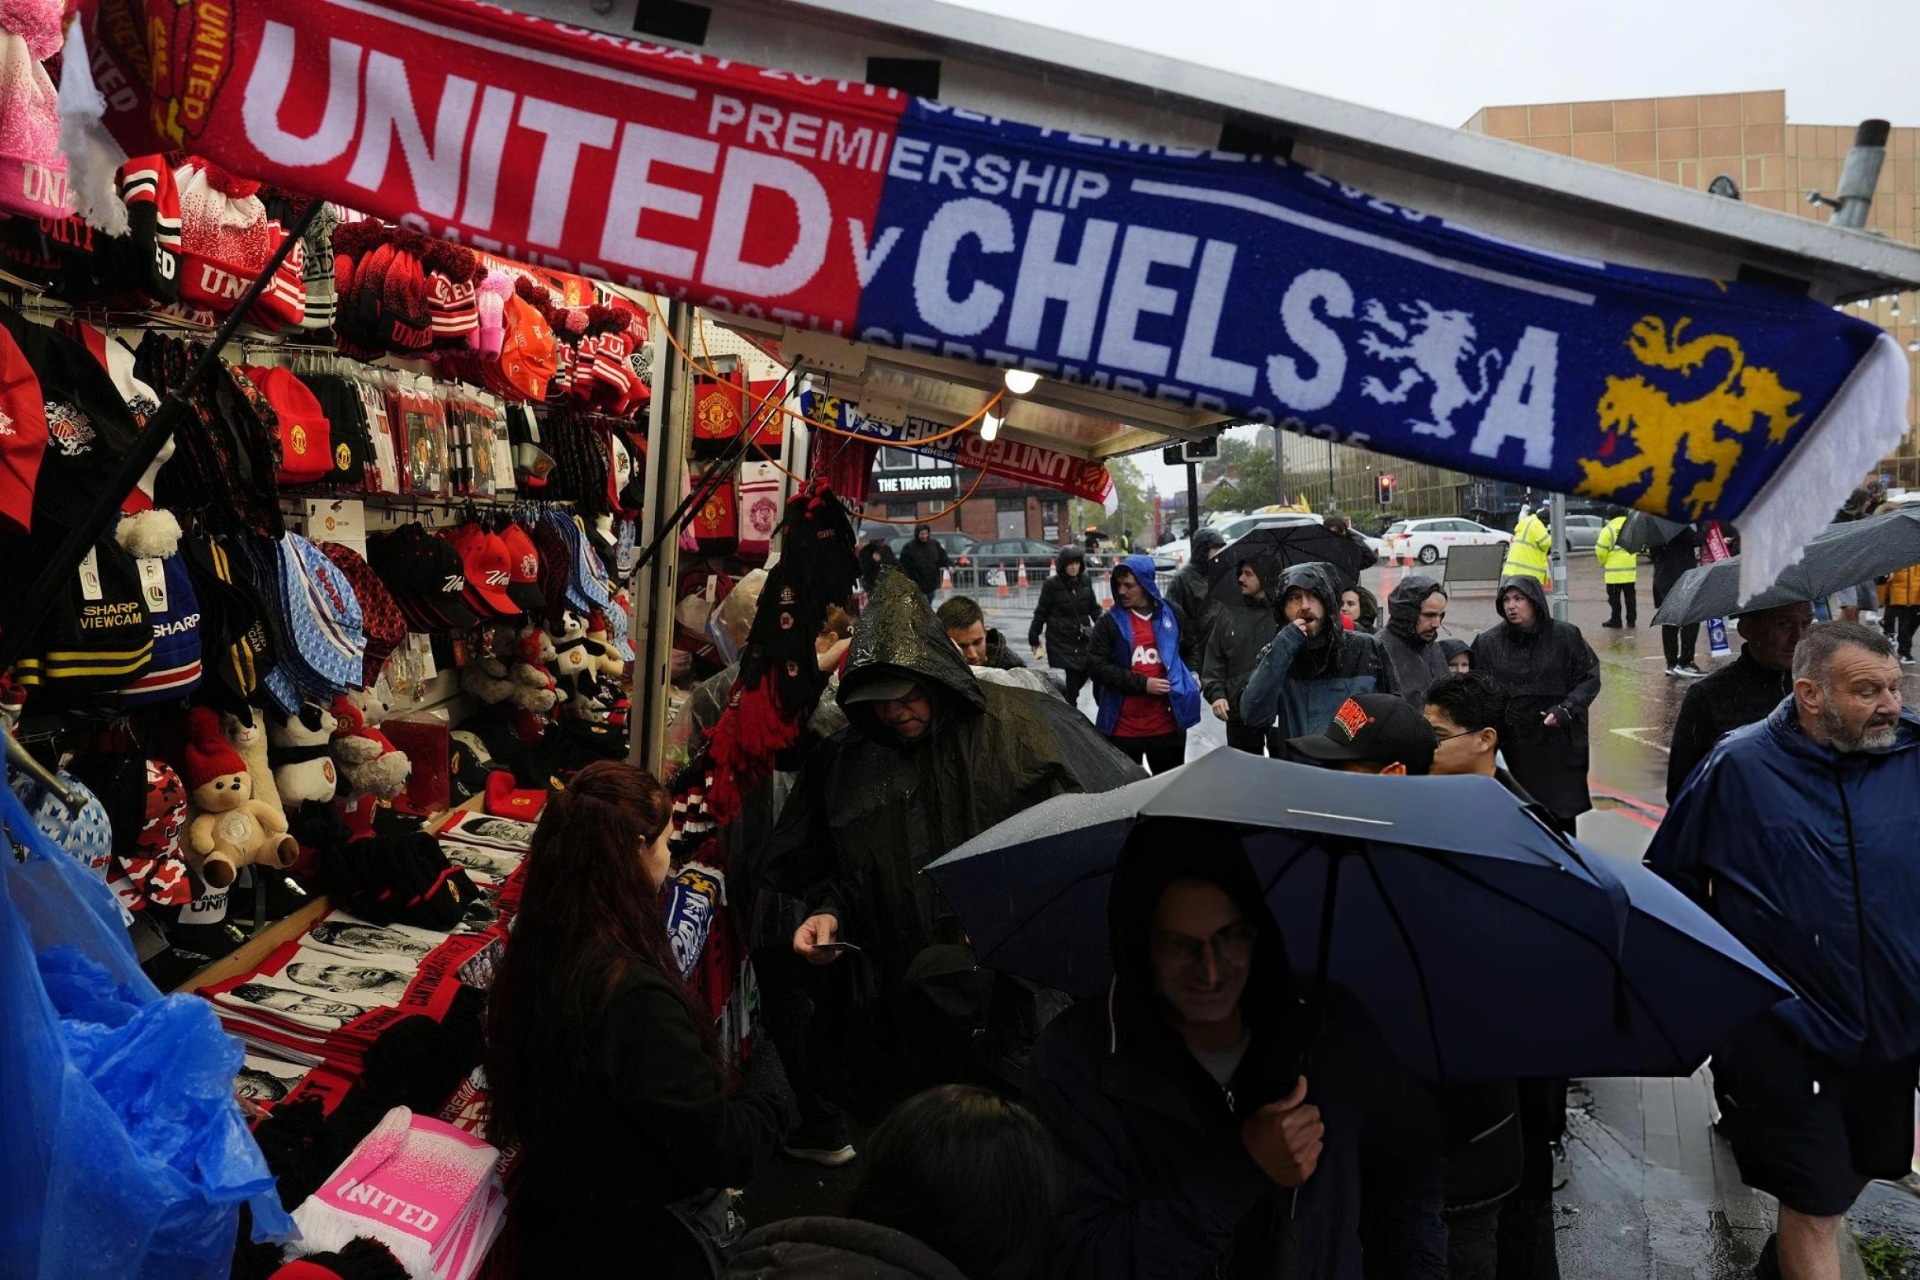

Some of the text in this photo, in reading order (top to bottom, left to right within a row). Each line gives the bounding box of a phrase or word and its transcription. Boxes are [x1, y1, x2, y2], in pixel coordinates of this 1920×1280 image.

[182, 2, 229, 120] UNITED
[242, 20, 833, 299] UNITED
[707, 93, 1110, 210] PREMIERSHIP
[878, 475, 952, 493] THE TRAFFORD
[80, 612, 142, 630] VIEWCAM
[83, 602, 139, 616] SHARP
[152, 613, 200, 638] SHARP
